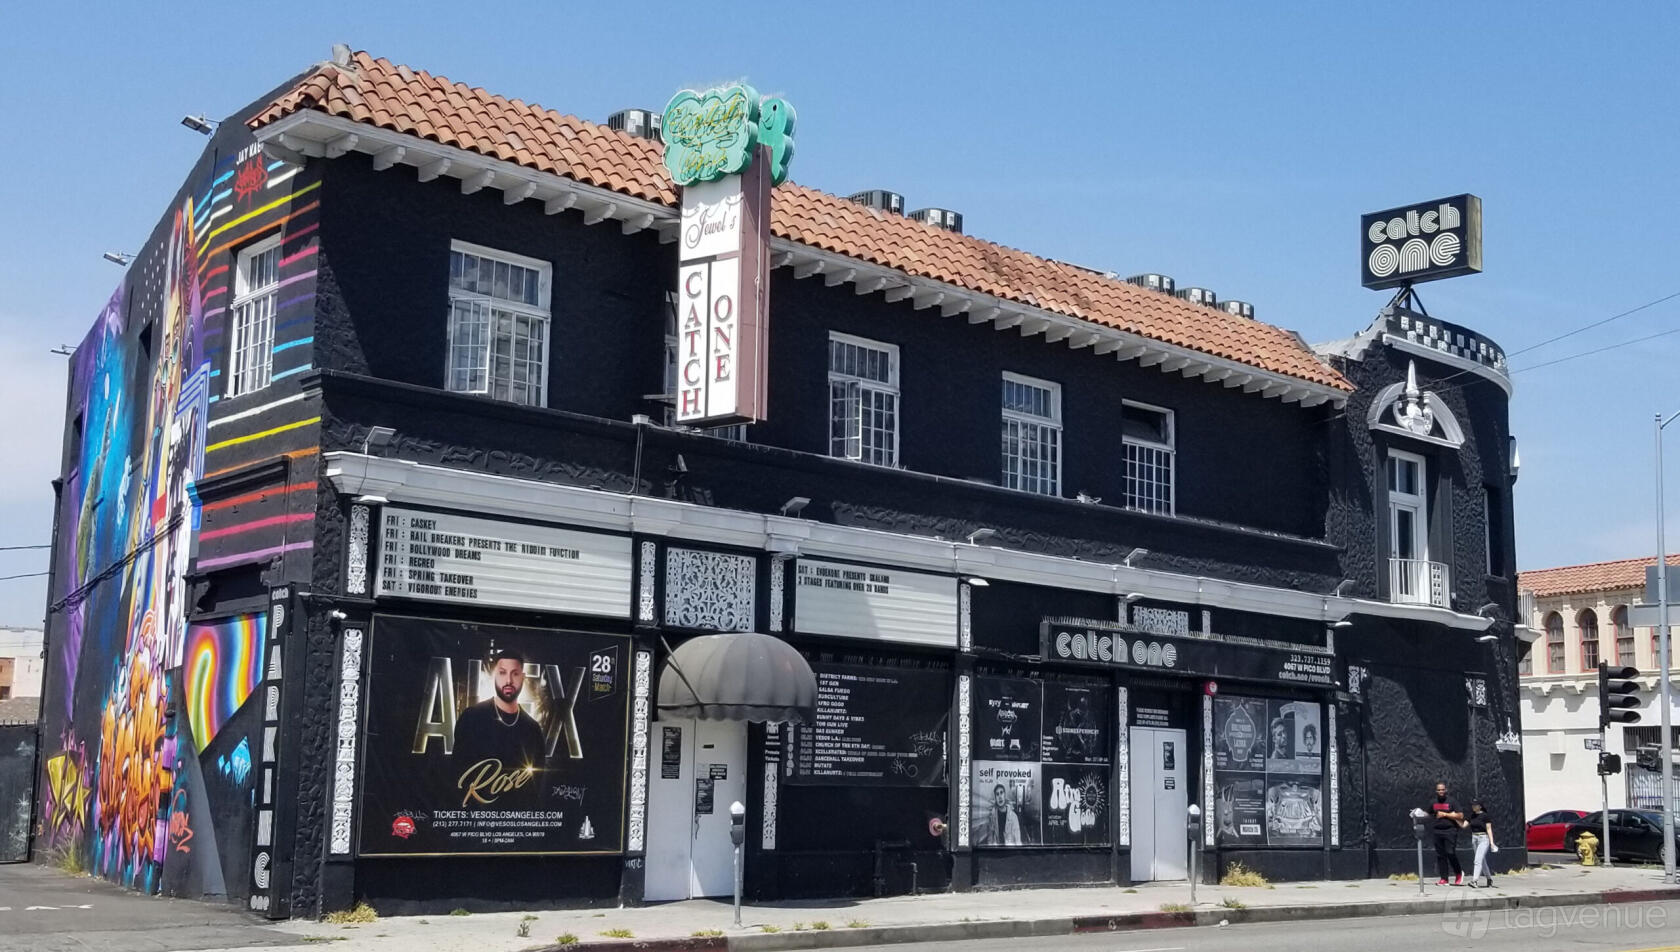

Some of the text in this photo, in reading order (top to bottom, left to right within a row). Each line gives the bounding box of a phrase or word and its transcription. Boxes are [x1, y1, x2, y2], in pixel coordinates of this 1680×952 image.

[1368, 203, 1460, 243] catch
[1368, 232, 1461, 277] one
[681, 271, 703, 417] CATCH
[714, 294, 734, 383] ONE
[410, 518, 437, 530] CASKEY
[410, 531, 427, 542] RAIL
[431, 533, 465, 546] BREAKERS
[468, 537, 501, 551] PRESENTS
[505, 541, 517, 553] THE
[549, 547, 580, 560] FUNCTION
[410, 544, 451, 557] BOLLYWOOD
[455, 548, 481, 561] DREAMS
[409, 556, 435, 569] RECREO
[408, 569, 435, 582] SPRING
[440, 572, 474, 585] TAKEOVER
[843, 570, 866, 581] PRESENTS
[408, 583, 442, 595] VIGOROUS
[445, 586, 478, 599] ENERGIES
[804, 576, 822, 587] STAGES
[824, 579, 852, 590] FEATURING
[853, 581, 865, 592] OVER
[874, 584, 889, 594] BANDS
[1056, 630, 1177, 668] catch one
[592, 654, 611, 673] 28
[1304, 664, 1316, 673] PICO
[1316, 665, 1331, 674] BLVD
[411, 657, 587, 759] AX
[254, 604, 285, 889] PARKING
[457, 758, 533, 808] Rose
[979, 768, 1032, 780] self provoked
[433, 810, 469, 819] TICKETS:
[470, 810, 563, 819] VESOSLOSANGELES.COM
[477, 820, 563, 828] INFO@VESOSLOSANGELES.COM
